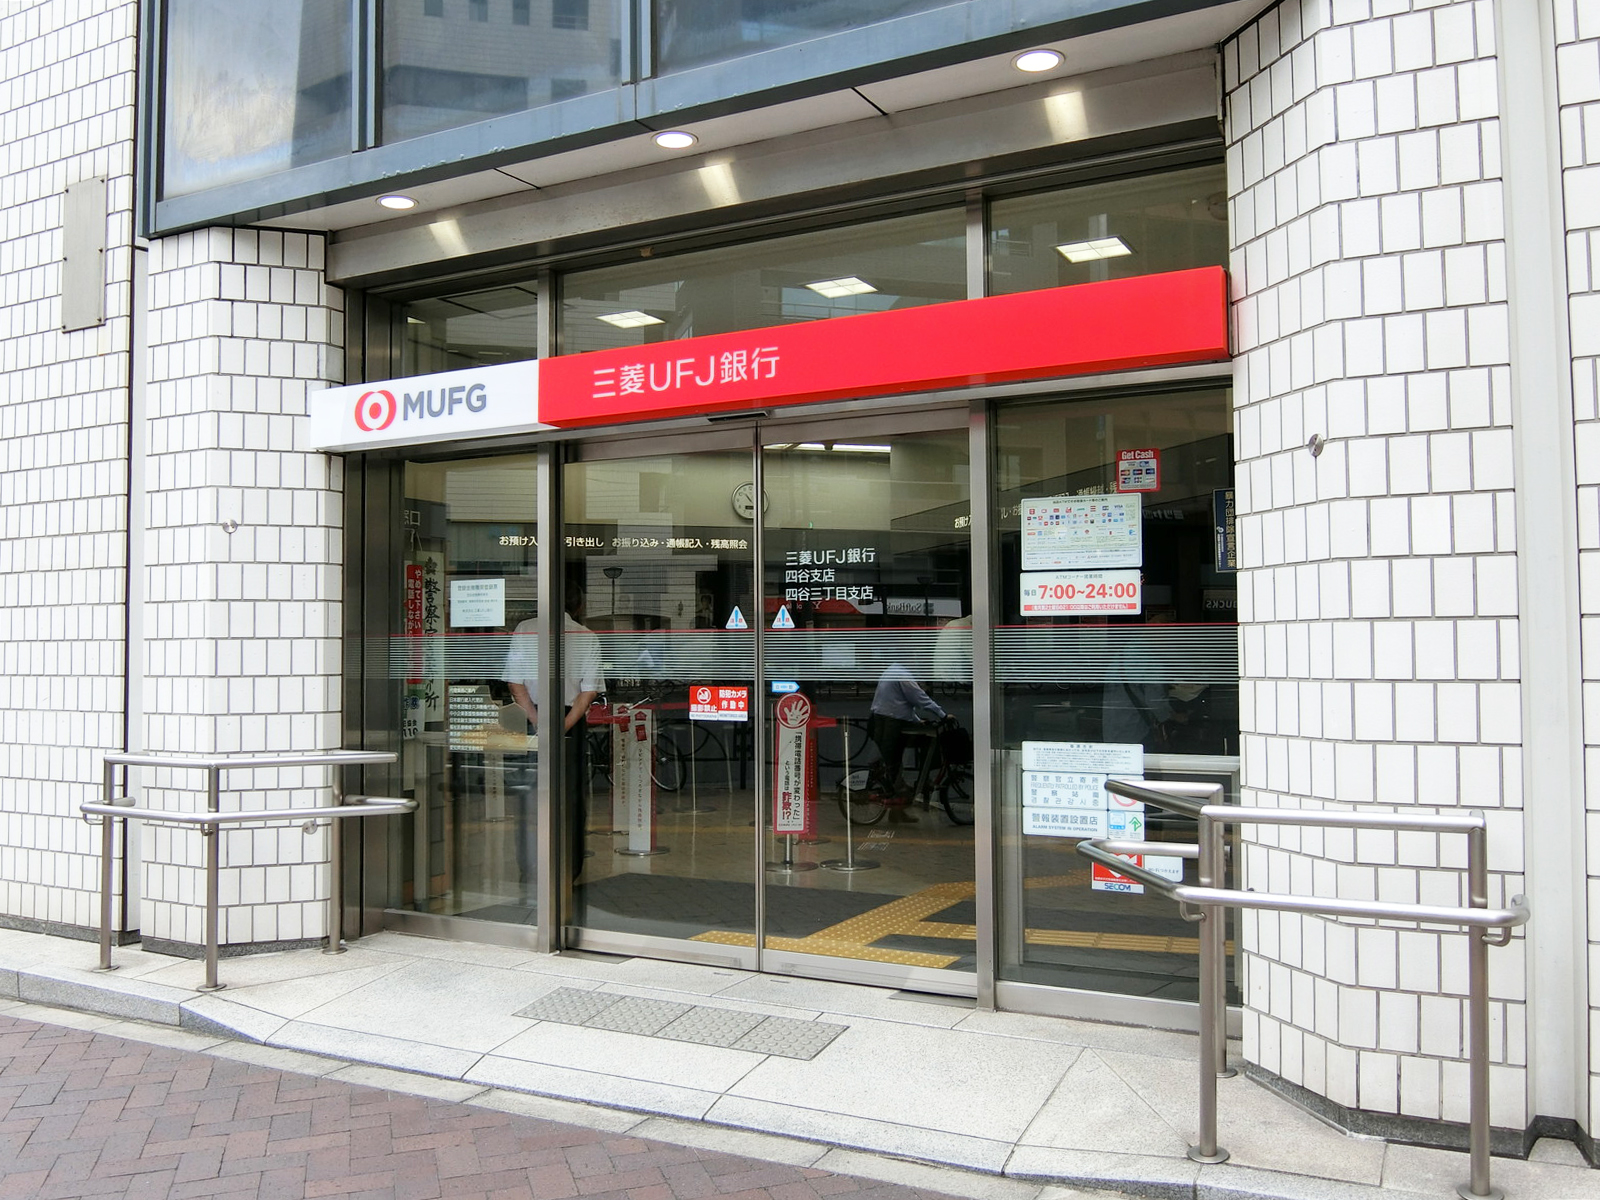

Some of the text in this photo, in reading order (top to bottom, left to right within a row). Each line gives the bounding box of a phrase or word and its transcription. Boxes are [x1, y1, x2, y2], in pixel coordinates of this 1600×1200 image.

[592, 346, 781, 399] 三菱UFJ銀行
[402, 383, 487, 421] MUFG
[1121, 449, 1154, 460] Get Cash
[785, 547, 876, 567] 三菱UFJ銀行
[785, 569, 836, 584] 四谷支店
[785, 585, 874, 602] 四谷三丁目支店
[1024, 588, 1037, 597] 毎日
[719, 689, 747, 699] 防犯カメラ
[690, 703, 718, 712] 撮影禁止
[721, 700, 745, 709] 作動中
[1031, 774, 1099, 784] 警察官立寄所
[1031, 812, 1098, 826] 警報装置設置店
[1104, 882, 1132, 892] SECOM
